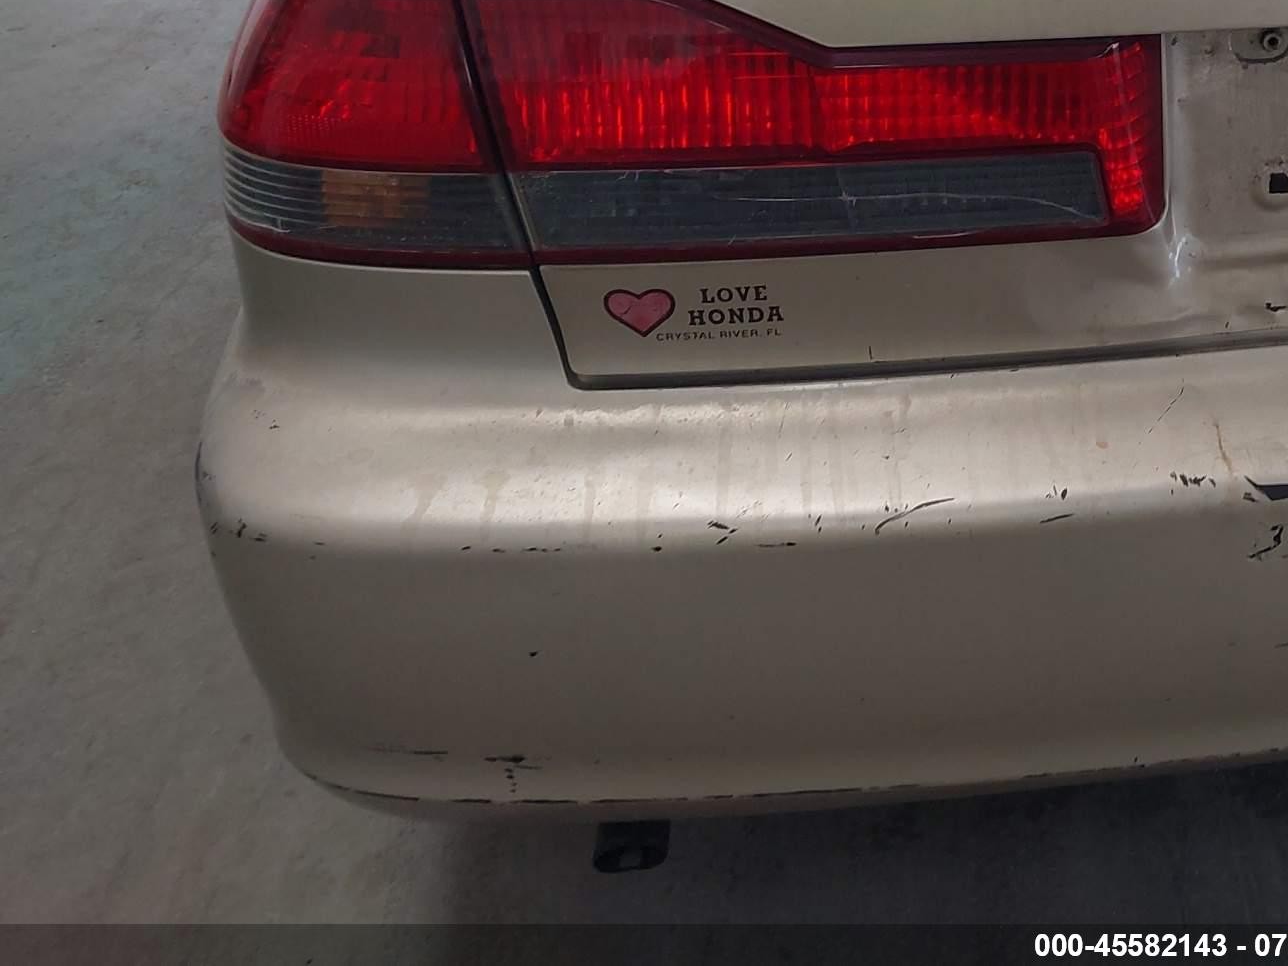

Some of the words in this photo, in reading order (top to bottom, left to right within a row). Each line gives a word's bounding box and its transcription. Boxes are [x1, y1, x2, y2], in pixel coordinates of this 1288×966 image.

[700, 284, 768, 303] LOVE
[688, 306, 784, 326] HONDA
[656, 332, 715, 342] CRYSTAL
[767, 328, 781, 336] FL
